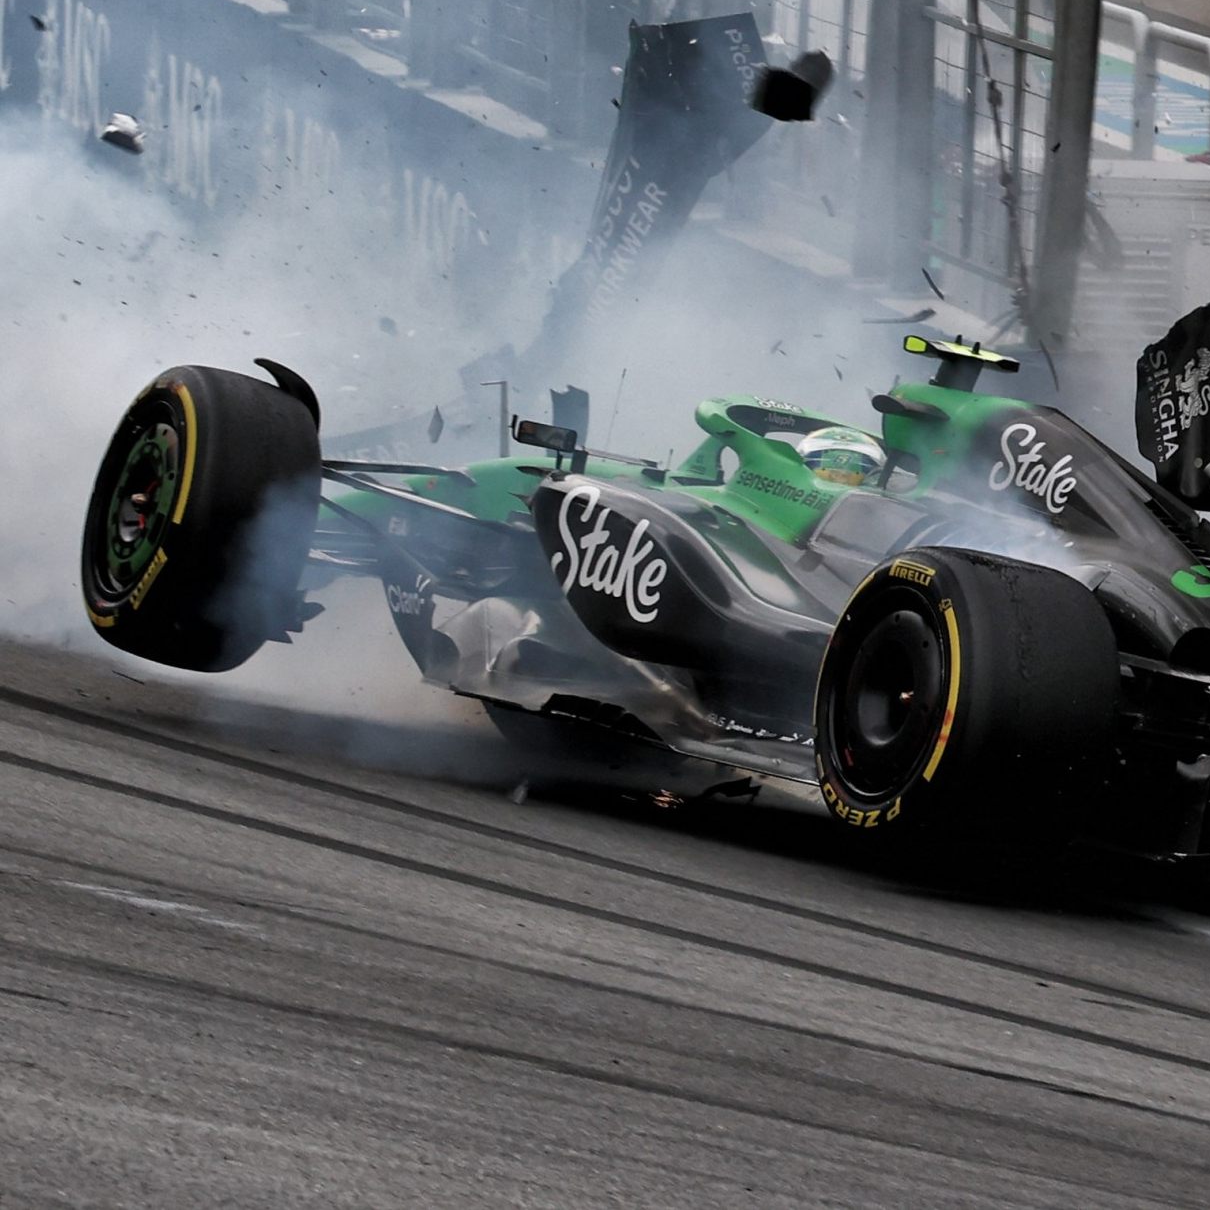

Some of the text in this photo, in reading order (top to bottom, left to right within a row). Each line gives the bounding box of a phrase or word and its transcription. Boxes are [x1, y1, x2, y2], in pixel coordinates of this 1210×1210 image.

[724, 29, 757, 104] PicPa
[1150, 350, 1180, 460] SINGHA
[736, 470, 805, 504] sensetime
[989, 423, 1077, 513] Stake
[551, 486, 668, 623] Stake
[888, 559, 936, 587] PIRELLI
[823, 782, 882, 828] ZERO
